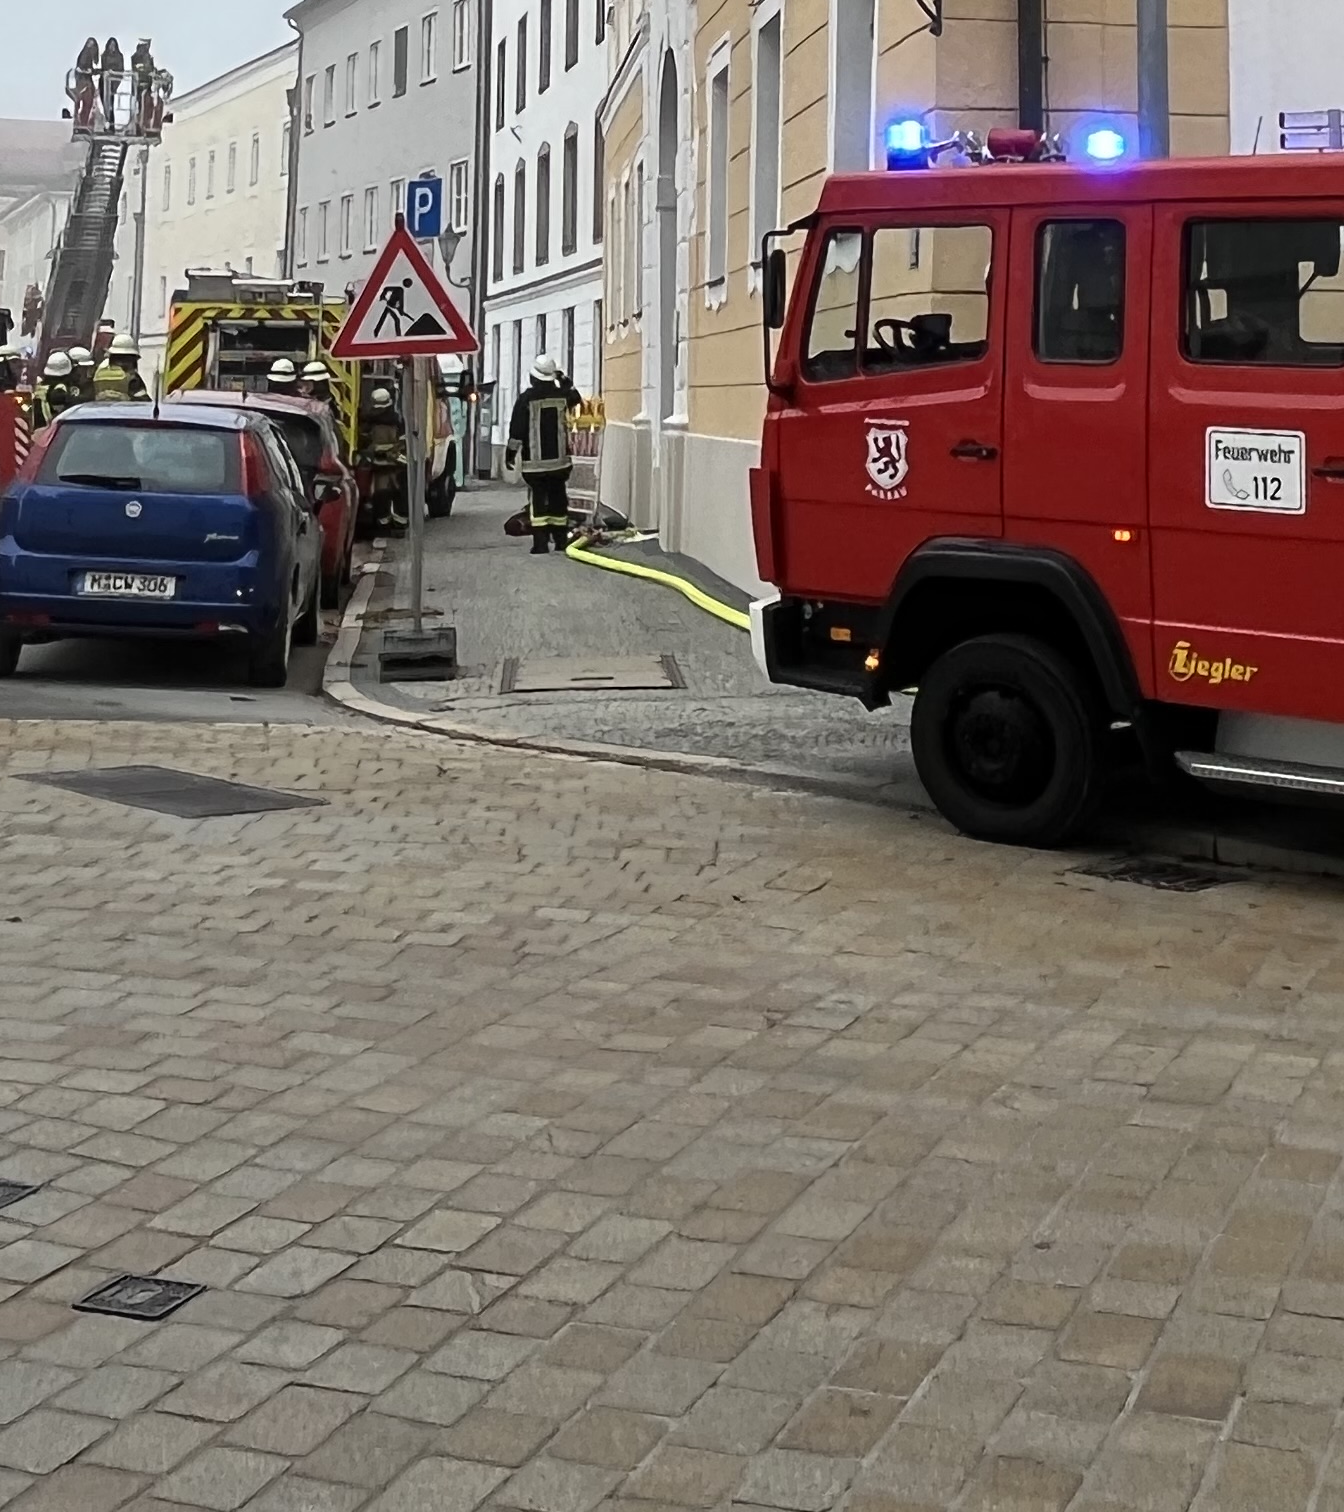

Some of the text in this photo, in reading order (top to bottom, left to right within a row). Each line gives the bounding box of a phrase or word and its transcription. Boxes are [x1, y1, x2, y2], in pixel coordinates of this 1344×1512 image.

[415, 188, 433, 231] P
[1215, 440, 1295, 464] Feuerwehr
[1253, 476, 1282, 501] 112
[1168, 640, 1258, 684] Ziegler
